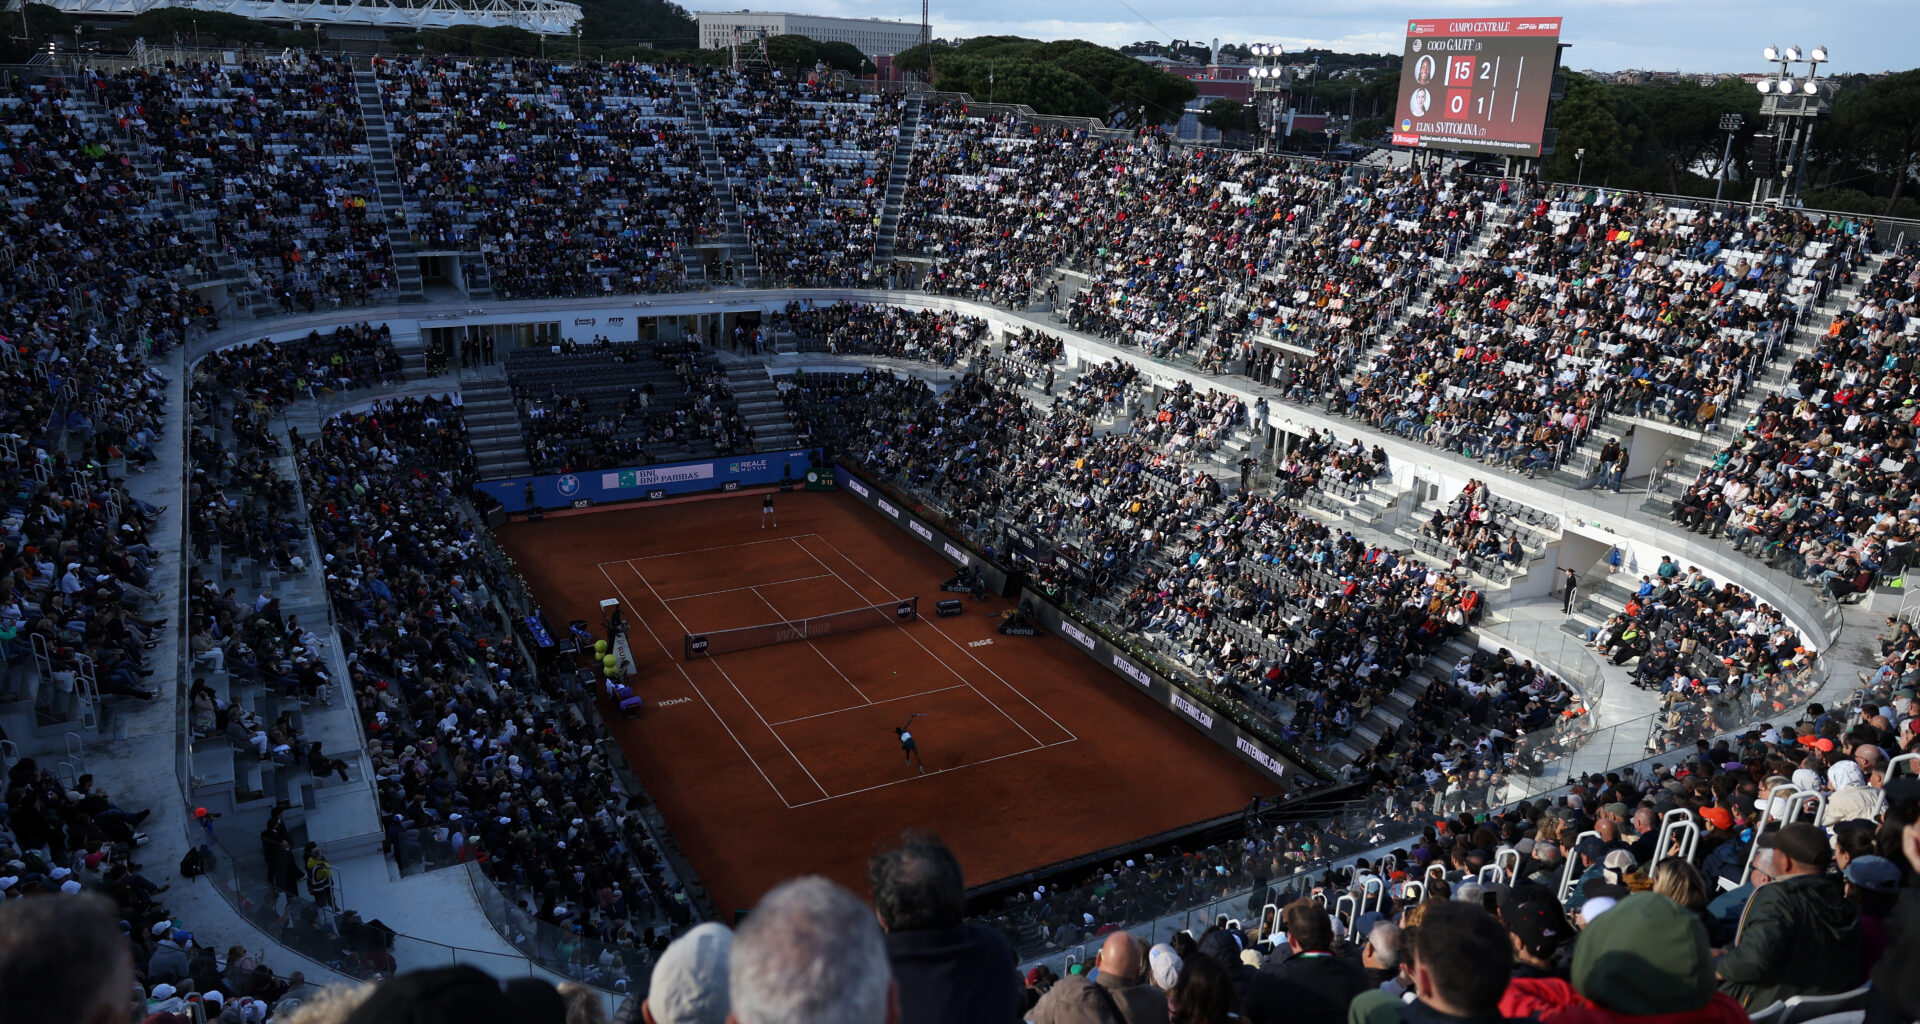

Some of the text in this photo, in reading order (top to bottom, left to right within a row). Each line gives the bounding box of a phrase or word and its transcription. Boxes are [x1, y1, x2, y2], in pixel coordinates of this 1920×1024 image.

[1449, 21, 1511, 32] CAMPO CENTRALE
[1427, 38, 1483, 52] COCO GAUFF (3)
[1454, 61, 1471, 80] 15
[1480, 62, 1491, 80] 2
[1451, 95, 1463, 114] 0
[1477, 96, 1484, 115] 1
[1416, 121, 1487, 137] ELINA SVITOLINA (7)
[740, 460, 767, 468] REALE
[640, 471, 699, 486] BNP PARIBAS
[725, 482, 737, 490] EA7
[650, 491, 663, 499] EA7
[574, 500, 588, 508] EA7
[898, 607, 911, 615] WTA
[692, 641, 708, 649] WTA
[1113, 655, 1151, 687] WTATENNIS.COM
[659, 697, 692, 707] ROMA
[1171, 693, 1213, 730] WTATENNIS.COM
[1236, 736, 1284, 777] WTATENNIS.COM
